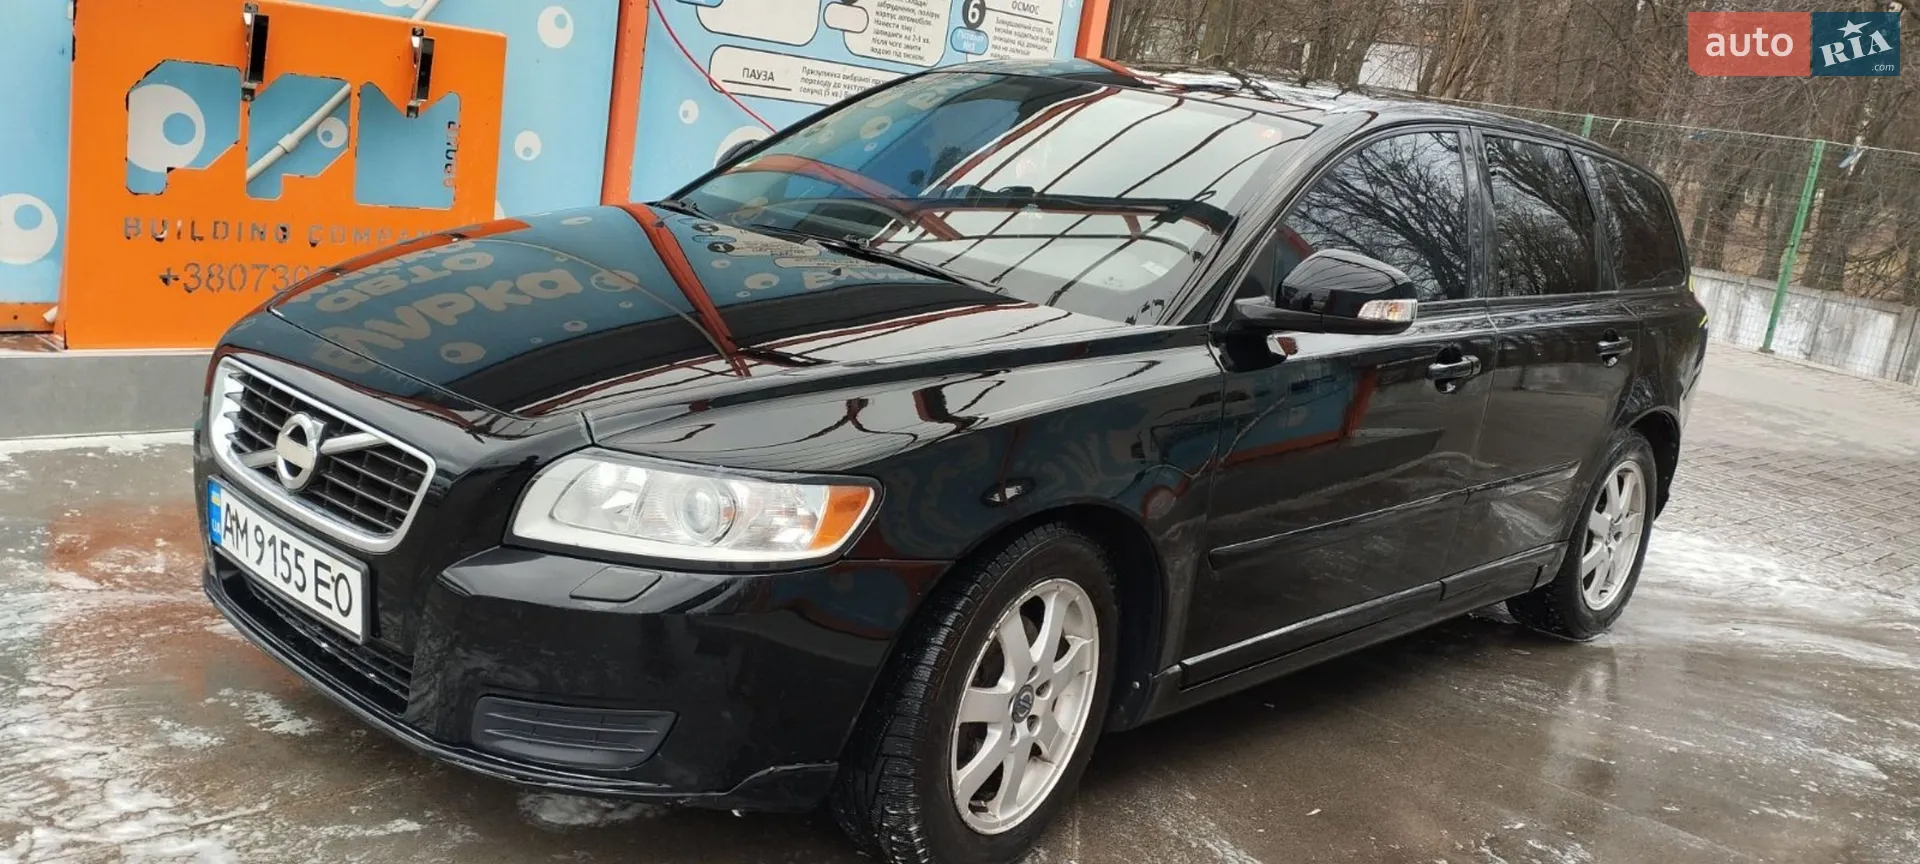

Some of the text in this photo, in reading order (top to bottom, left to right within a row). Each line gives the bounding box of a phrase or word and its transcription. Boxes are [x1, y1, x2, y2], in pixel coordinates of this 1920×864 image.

[968, 0, 980, 24] 6
[1011, 0, 1040, 15] ОСМОС
[742, 67, 775, 82] ПАУЗА
[799, 76, 832, 89] переходу
[833, 81, 842, 89] до
[124, 216, 291, 244] BUILDING
[159, 262, 328, 294] +380730
[223, 503, 353, 618] AM 9155 EO
